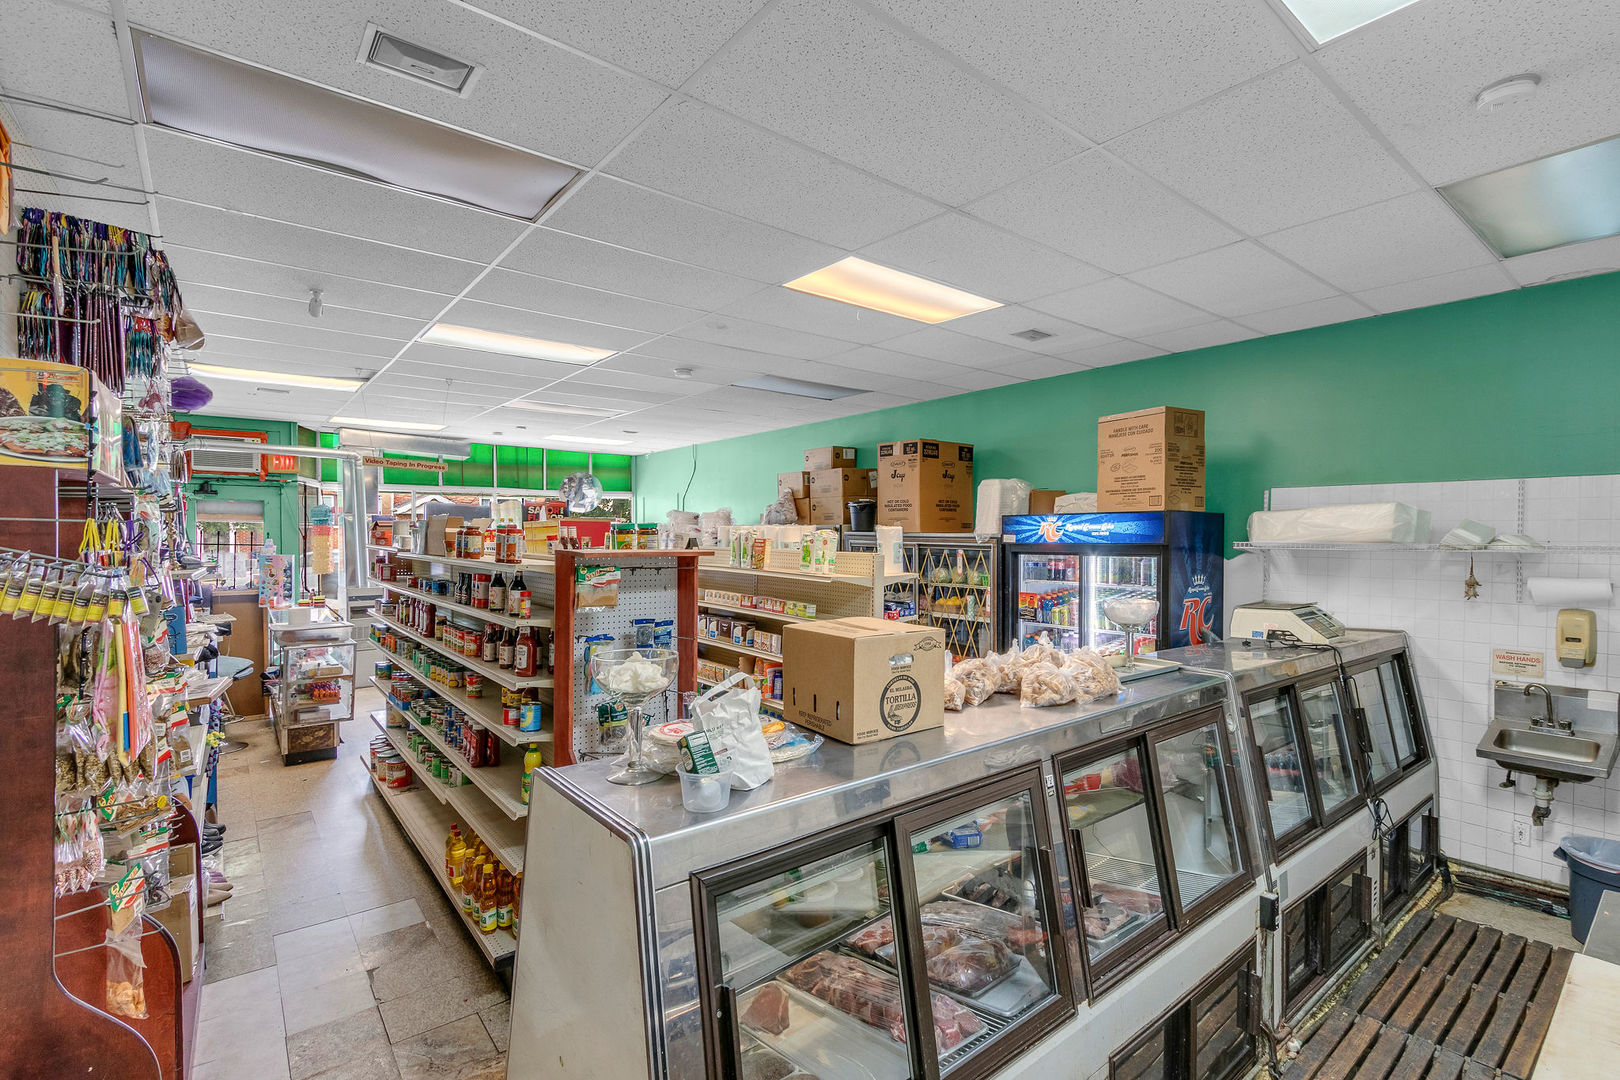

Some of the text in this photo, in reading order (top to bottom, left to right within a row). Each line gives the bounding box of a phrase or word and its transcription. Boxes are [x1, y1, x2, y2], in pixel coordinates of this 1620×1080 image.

[272, 455, 294, 470] EXIT
[386, 459, 407, 468] Taping
[417, 462, 446, 471] Progress
[1038, 521, 1064, 542] RC
[1180, 596, 1214, 646] RC
[885, 693, 916, 705] TORTILLA
